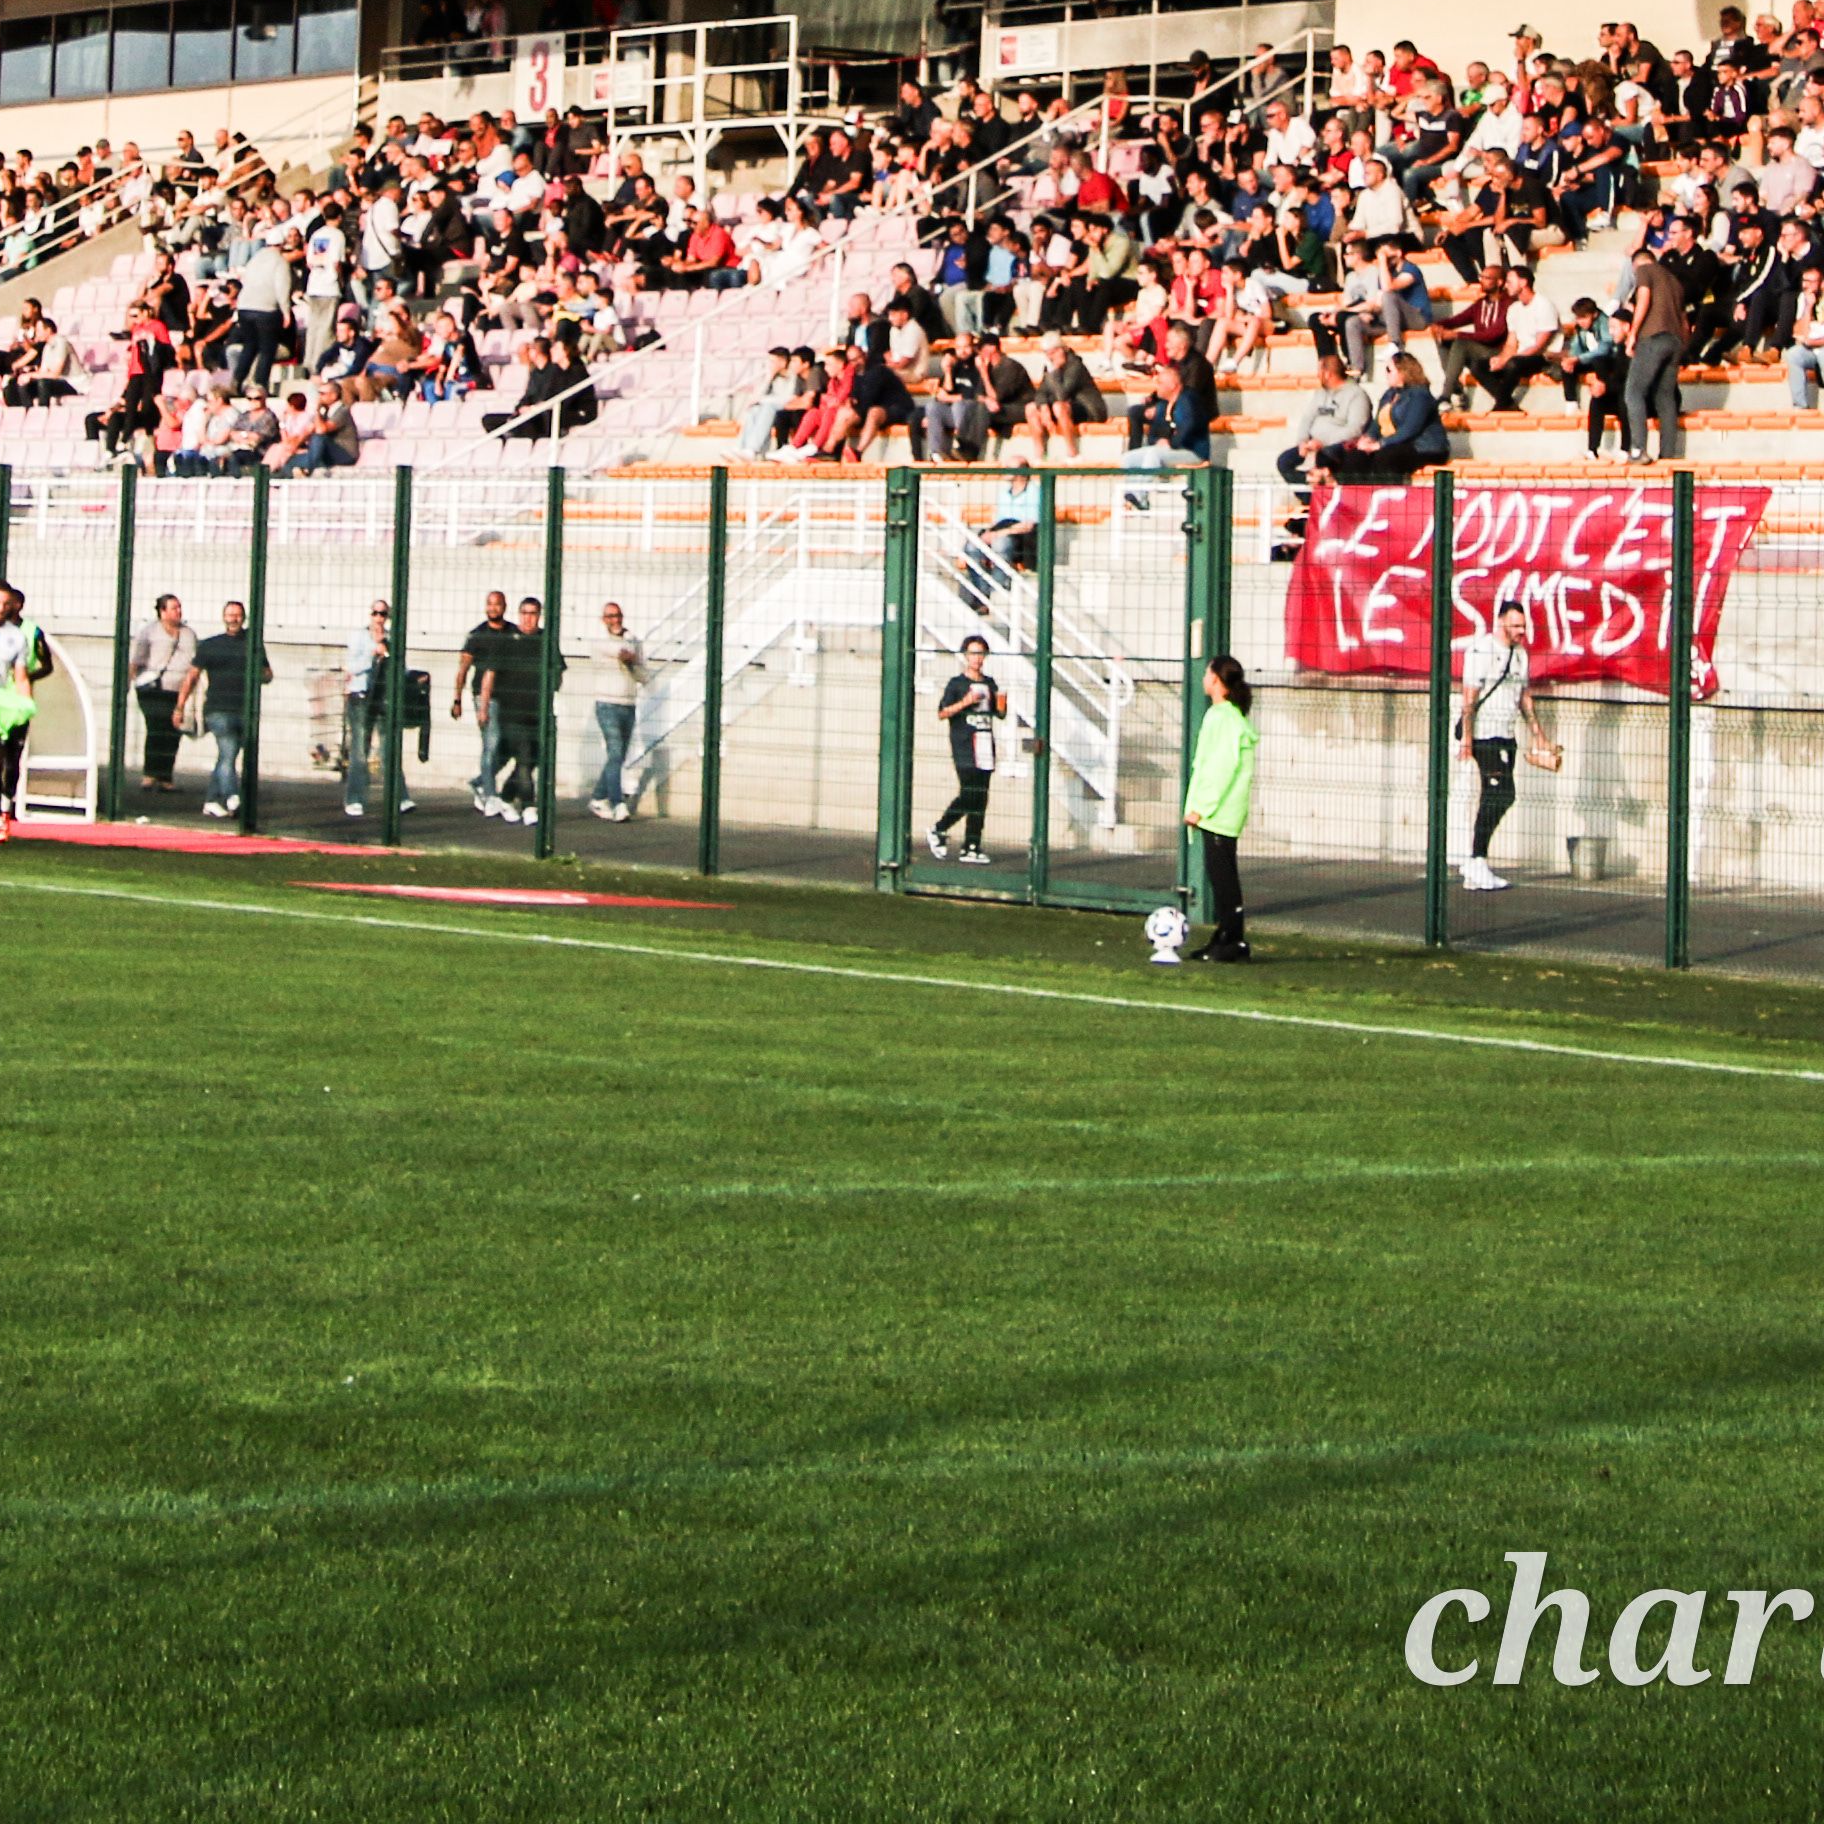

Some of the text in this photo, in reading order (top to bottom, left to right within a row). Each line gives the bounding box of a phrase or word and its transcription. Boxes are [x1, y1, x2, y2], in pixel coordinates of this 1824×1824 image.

[529, 40, 550, 113] 3
[1314, 486, 1407, 558] LE
[1332, 565, 1428, 653] LE
